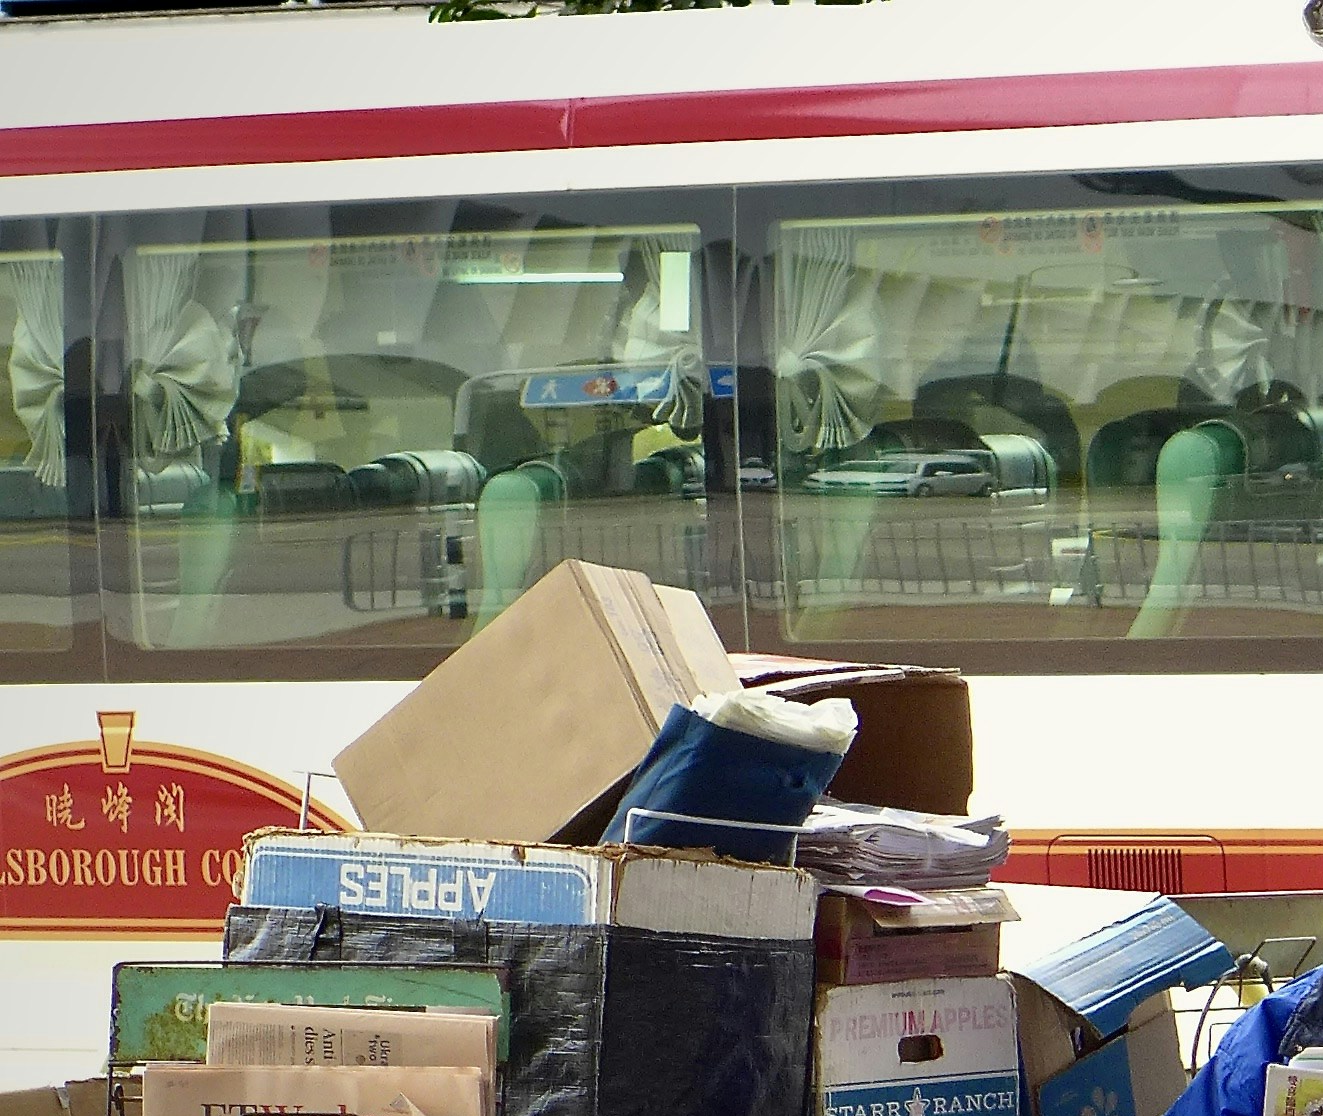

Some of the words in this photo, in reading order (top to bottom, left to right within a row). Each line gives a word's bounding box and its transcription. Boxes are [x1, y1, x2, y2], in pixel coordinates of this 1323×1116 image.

[340, 861, 494, 914] APPLES
[829, 1009, 926, 1042] PREMIUM
[930, 1004, 1009, 1034] APPLES
[932, 1091, 1015, 1114] RANCH
